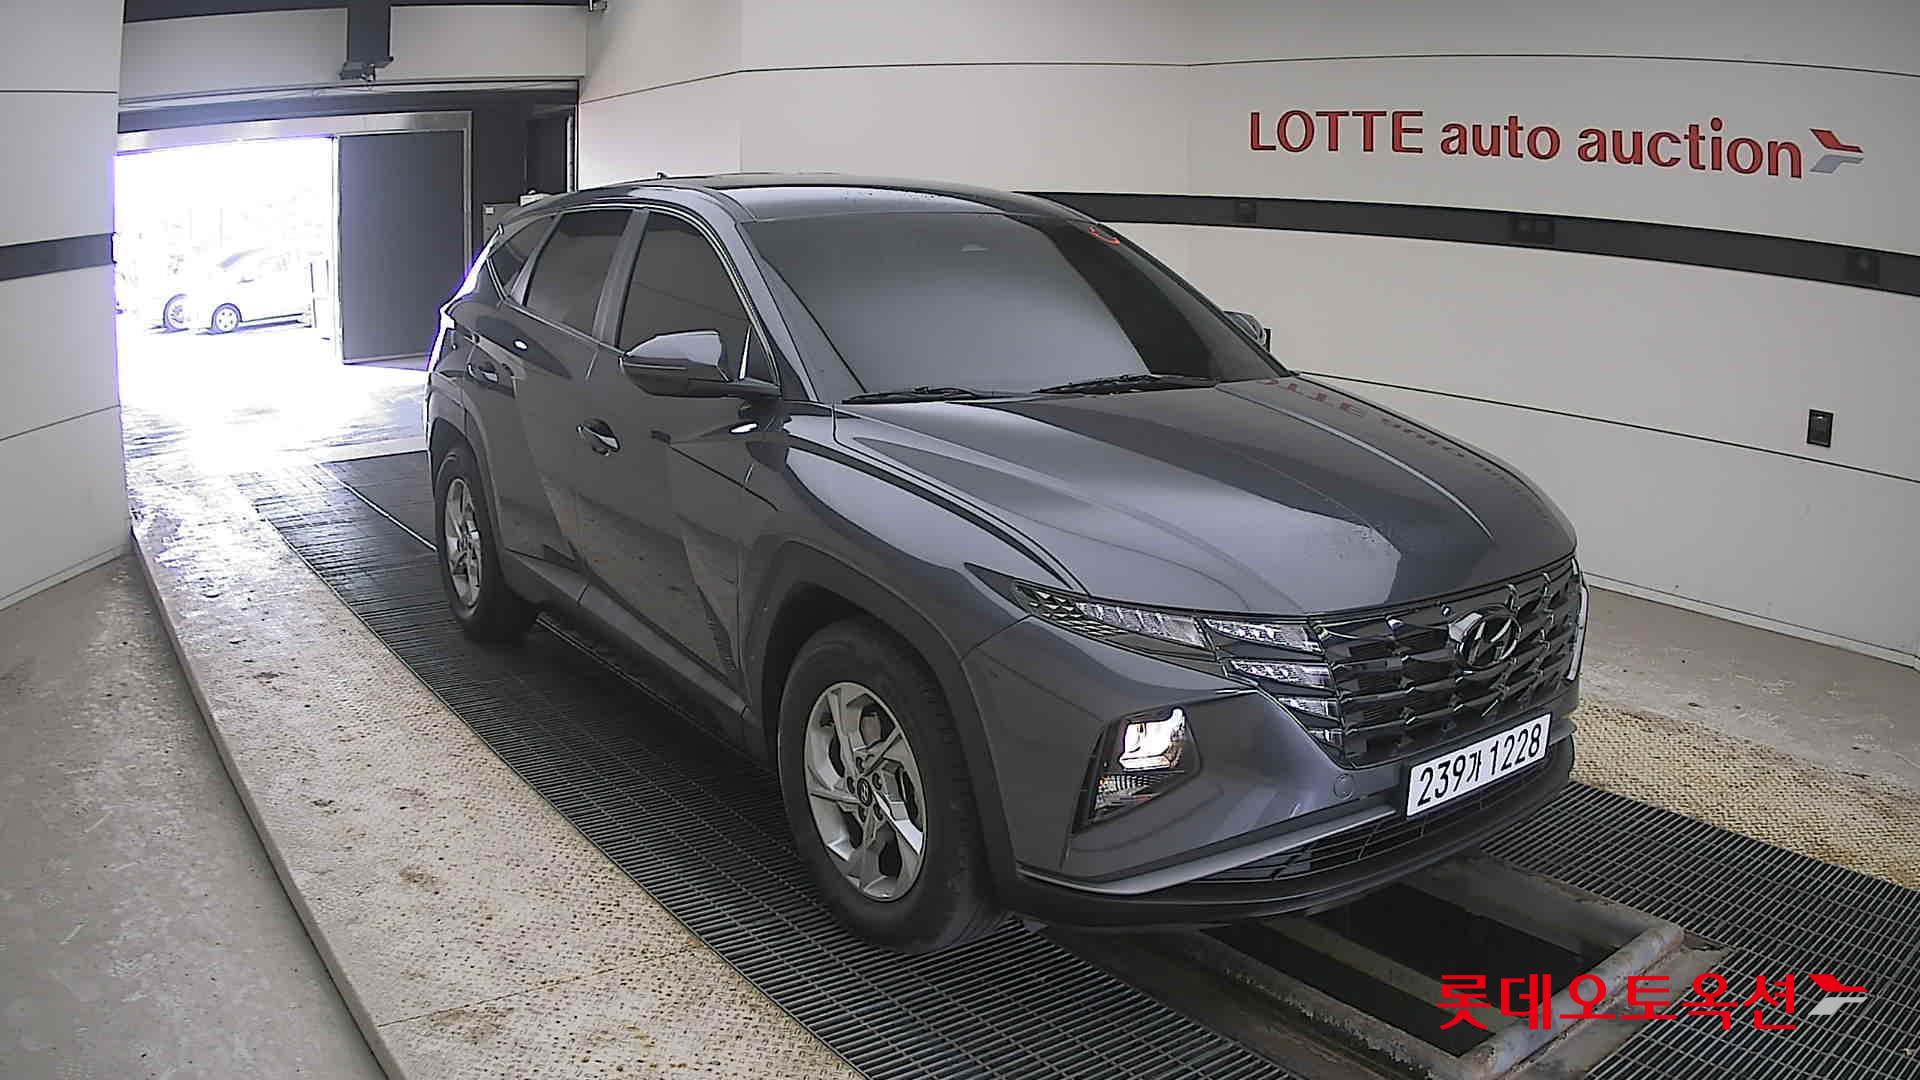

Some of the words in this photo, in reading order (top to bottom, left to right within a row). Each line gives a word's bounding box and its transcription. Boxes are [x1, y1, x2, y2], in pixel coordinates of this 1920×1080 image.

[1249, 110, 1424, 155] LOTTE
[1440, 115, 1562, 160] auto
[1577, 117, 1804, 178] auction
[1416, 750, 1482, 808] 239가
[1489, 723, 1542, 776] 1228
